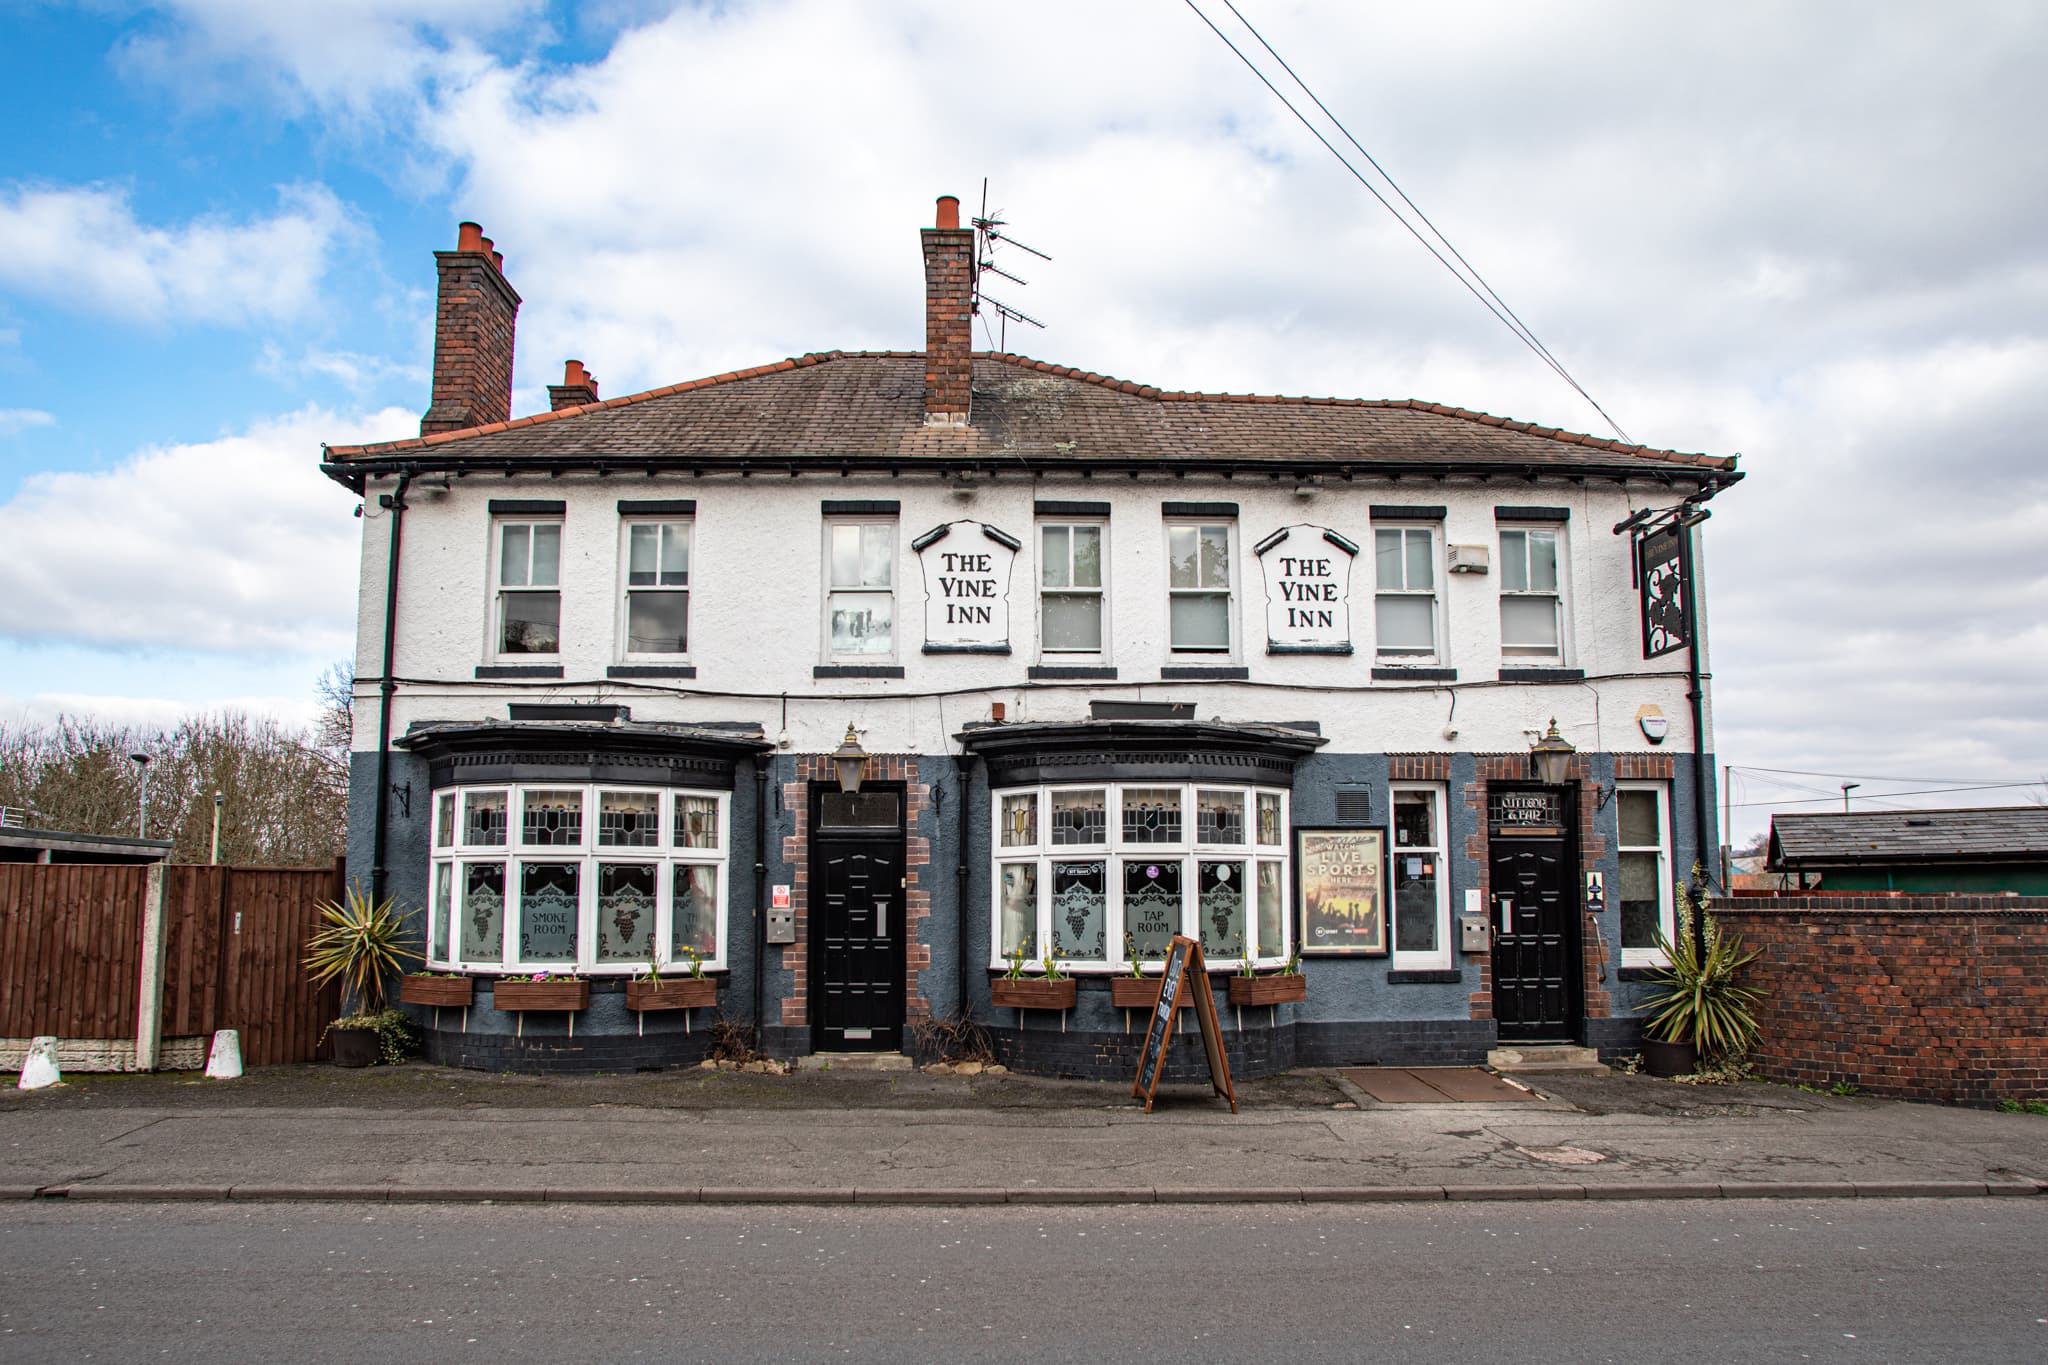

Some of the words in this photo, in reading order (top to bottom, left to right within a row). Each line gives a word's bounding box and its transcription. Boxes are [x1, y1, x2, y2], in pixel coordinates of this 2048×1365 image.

[941, 553, 991, 572] THE
[1280, 558, 1331, 577] THE
[939, 577, 997, 598] VINE
[1279, 581, 1338, 602] VINE
[947, 604, 991, 624] INN
[1288, 608, 1332, 627] INN
[1321, 851, 1360, 862] LIVE
[1307, 864, 1376, 876] SPORTS
[532, 912, 568, 923] SMOKE
[1144, 911, 1164, 921] TAP
[534, 924, 566, 934] ROOM
[1137, 922, 1169, 932] ROOM
